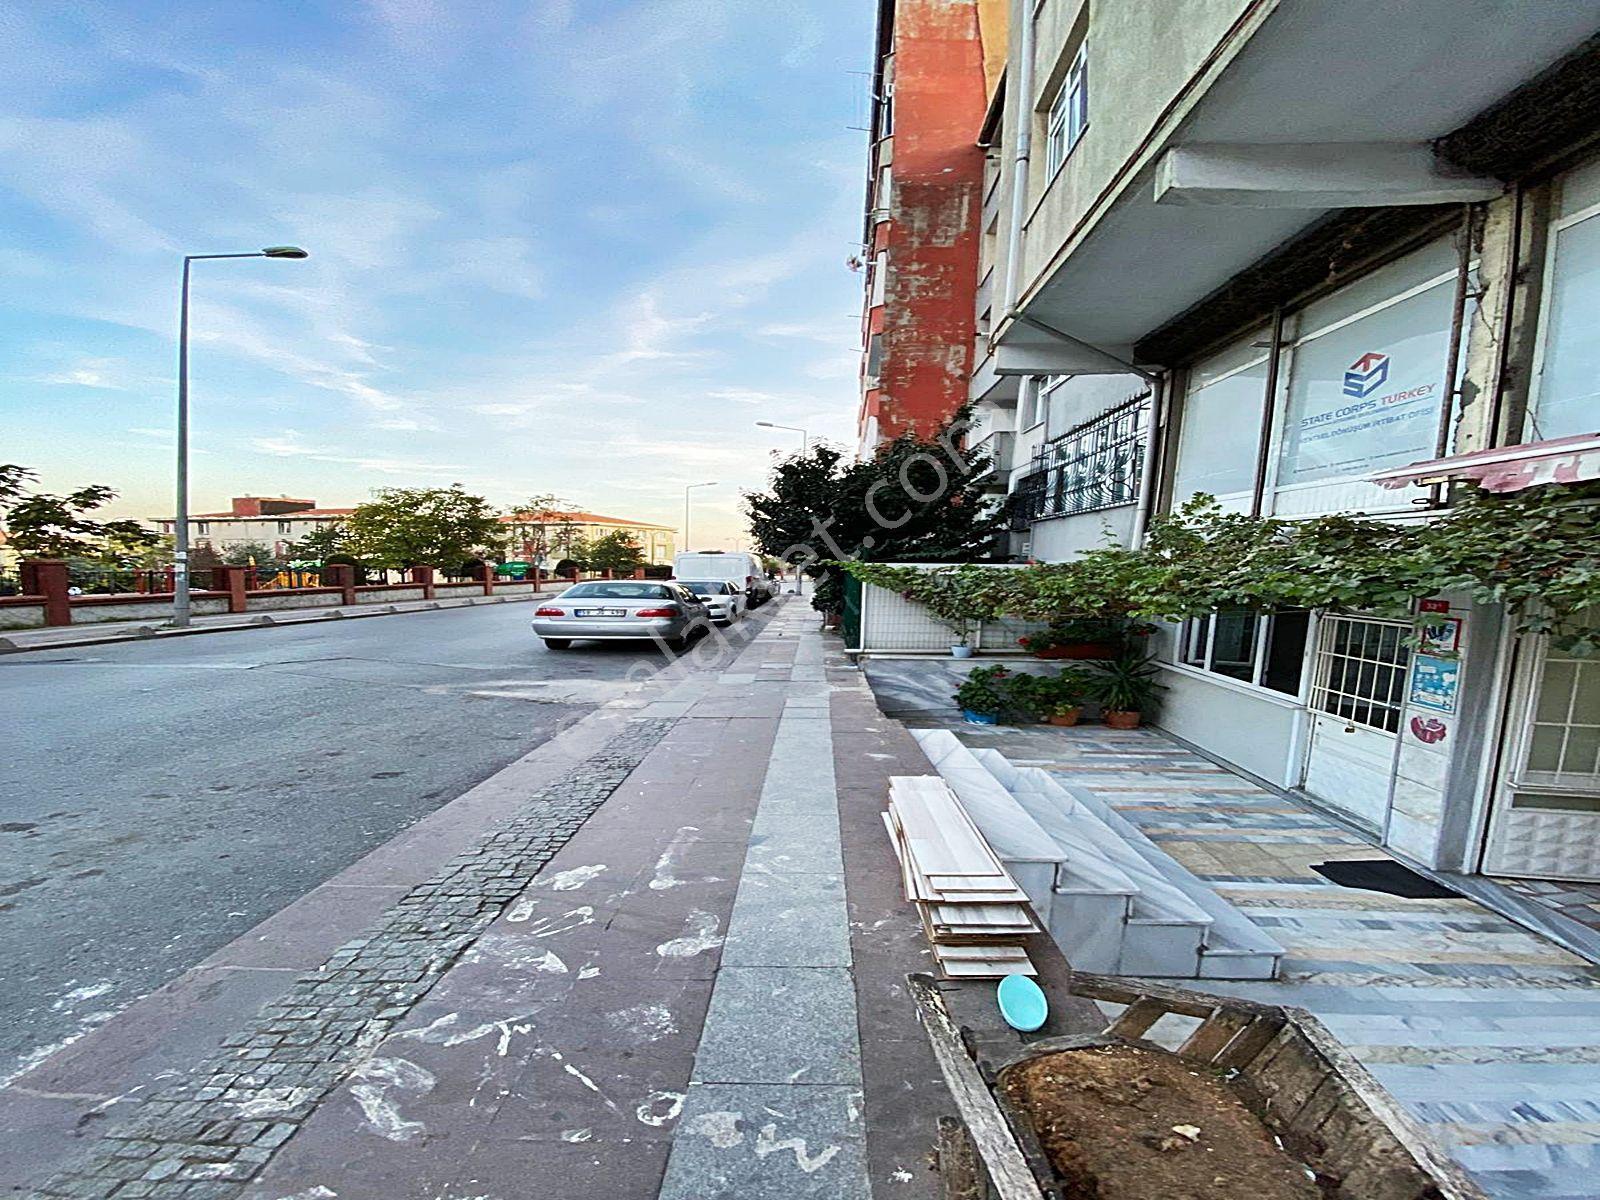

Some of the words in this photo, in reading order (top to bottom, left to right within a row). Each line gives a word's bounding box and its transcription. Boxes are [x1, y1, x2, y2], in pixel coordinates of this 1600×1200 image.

[1301, 412, 1333, 428] STATE
[1335, 400, 1377, 418] CORPS
[1381, 383, 1435, 405] TURKEY
